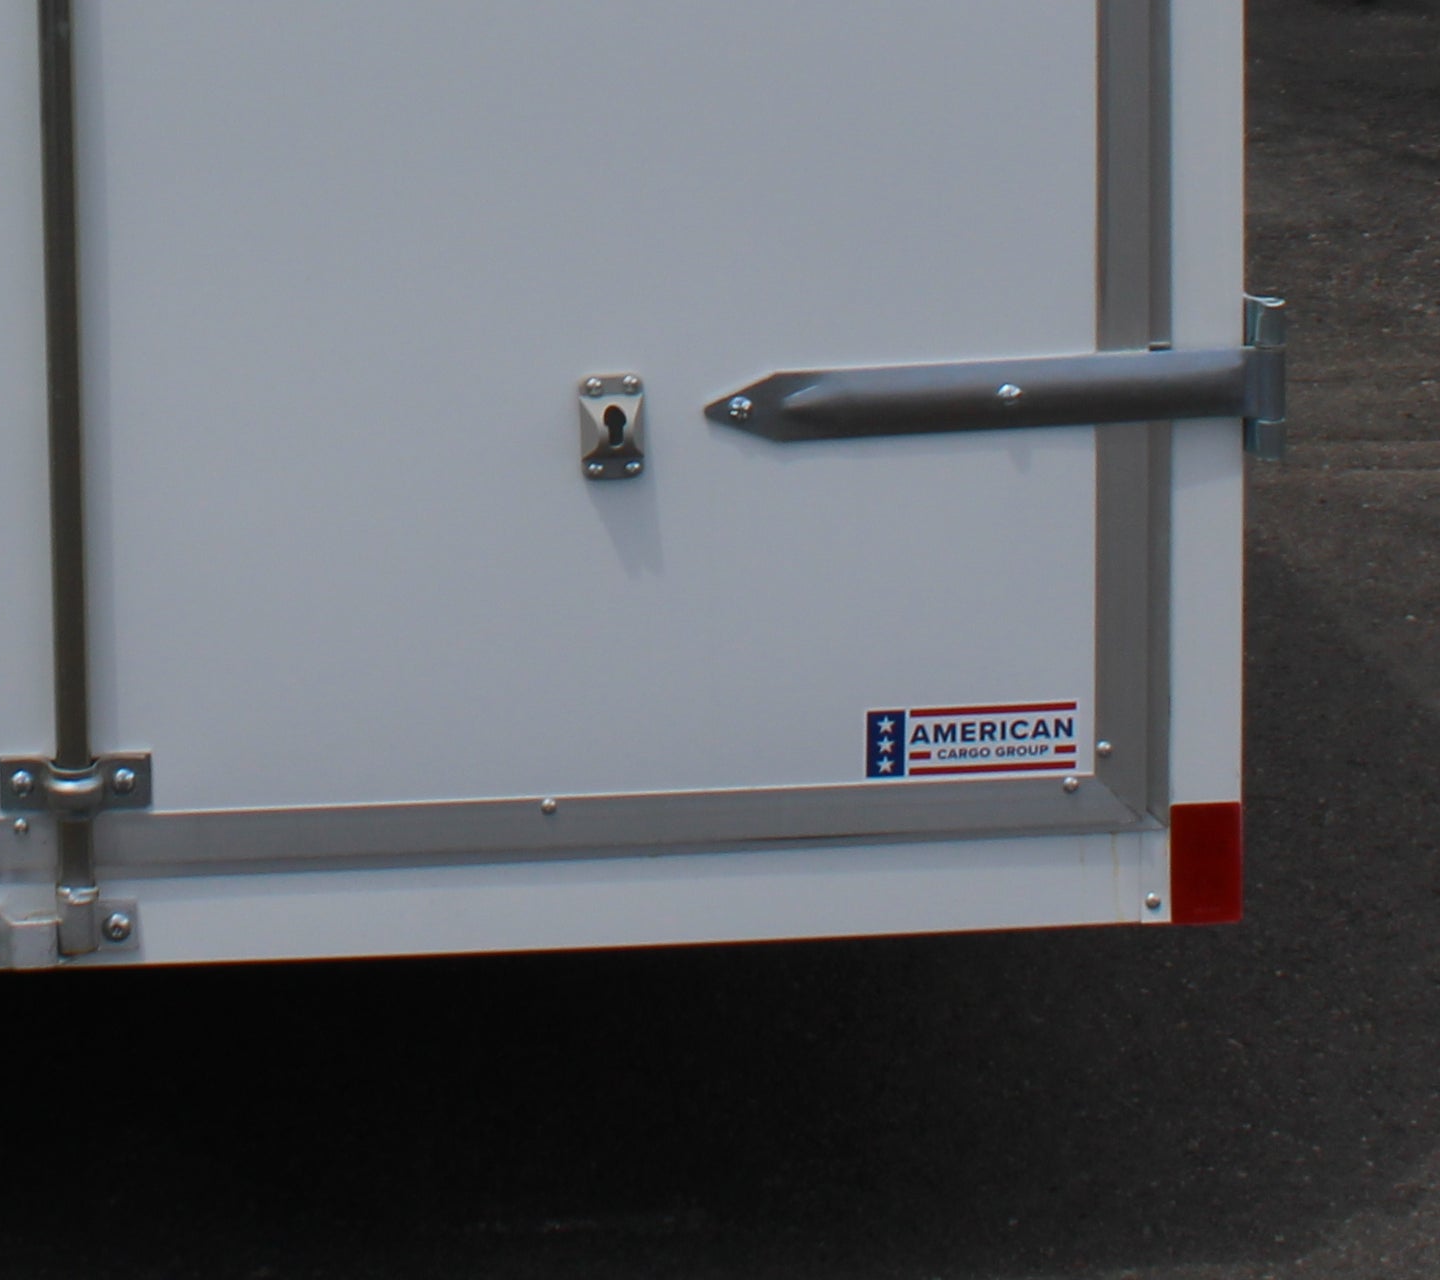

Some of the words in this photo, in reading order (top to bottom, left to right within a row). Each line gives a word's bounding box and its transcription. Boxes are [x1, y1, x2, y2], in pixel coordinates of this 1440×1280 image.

[909, 717, 1074, 745] AMERICAN
[937, 746, 991, 760] CARGO
[996, 744, 1049, 758] GROUP
